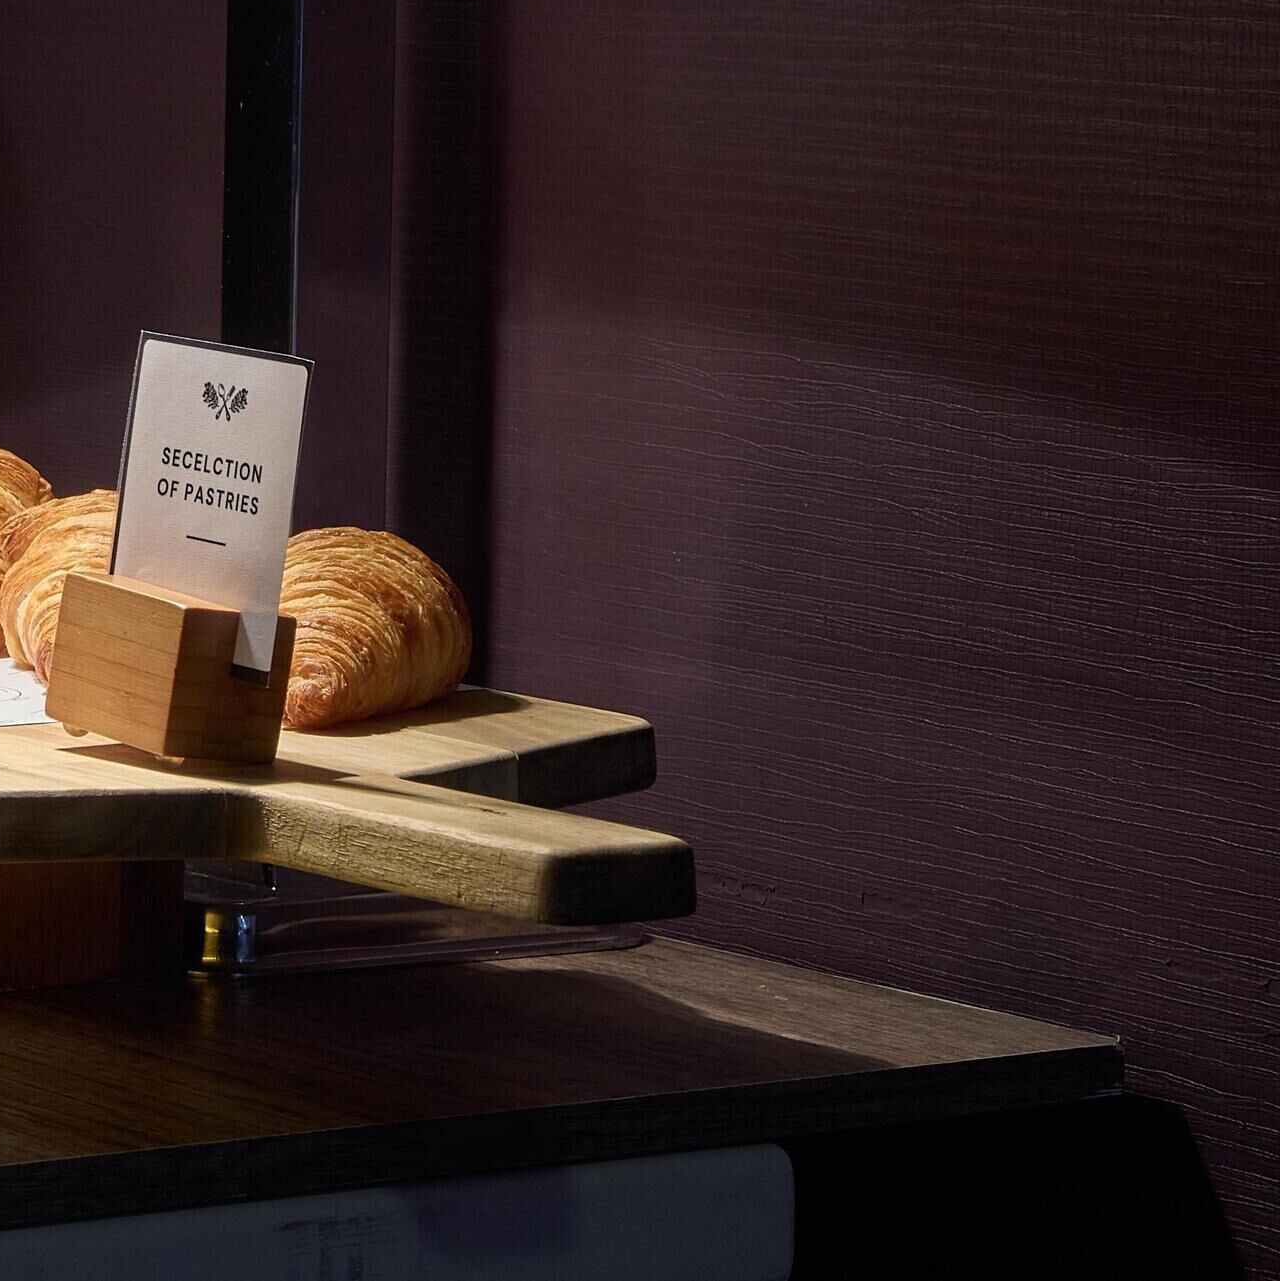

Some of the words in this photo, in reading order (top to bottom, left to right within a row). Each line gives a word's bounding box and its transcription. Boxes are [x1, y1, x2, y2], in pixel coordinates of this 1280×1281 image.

[161, 446, 263, 484] SECELCTION
[157, 477, 180, 498] OF
[183, 482, 260, 516] PASTRIES
